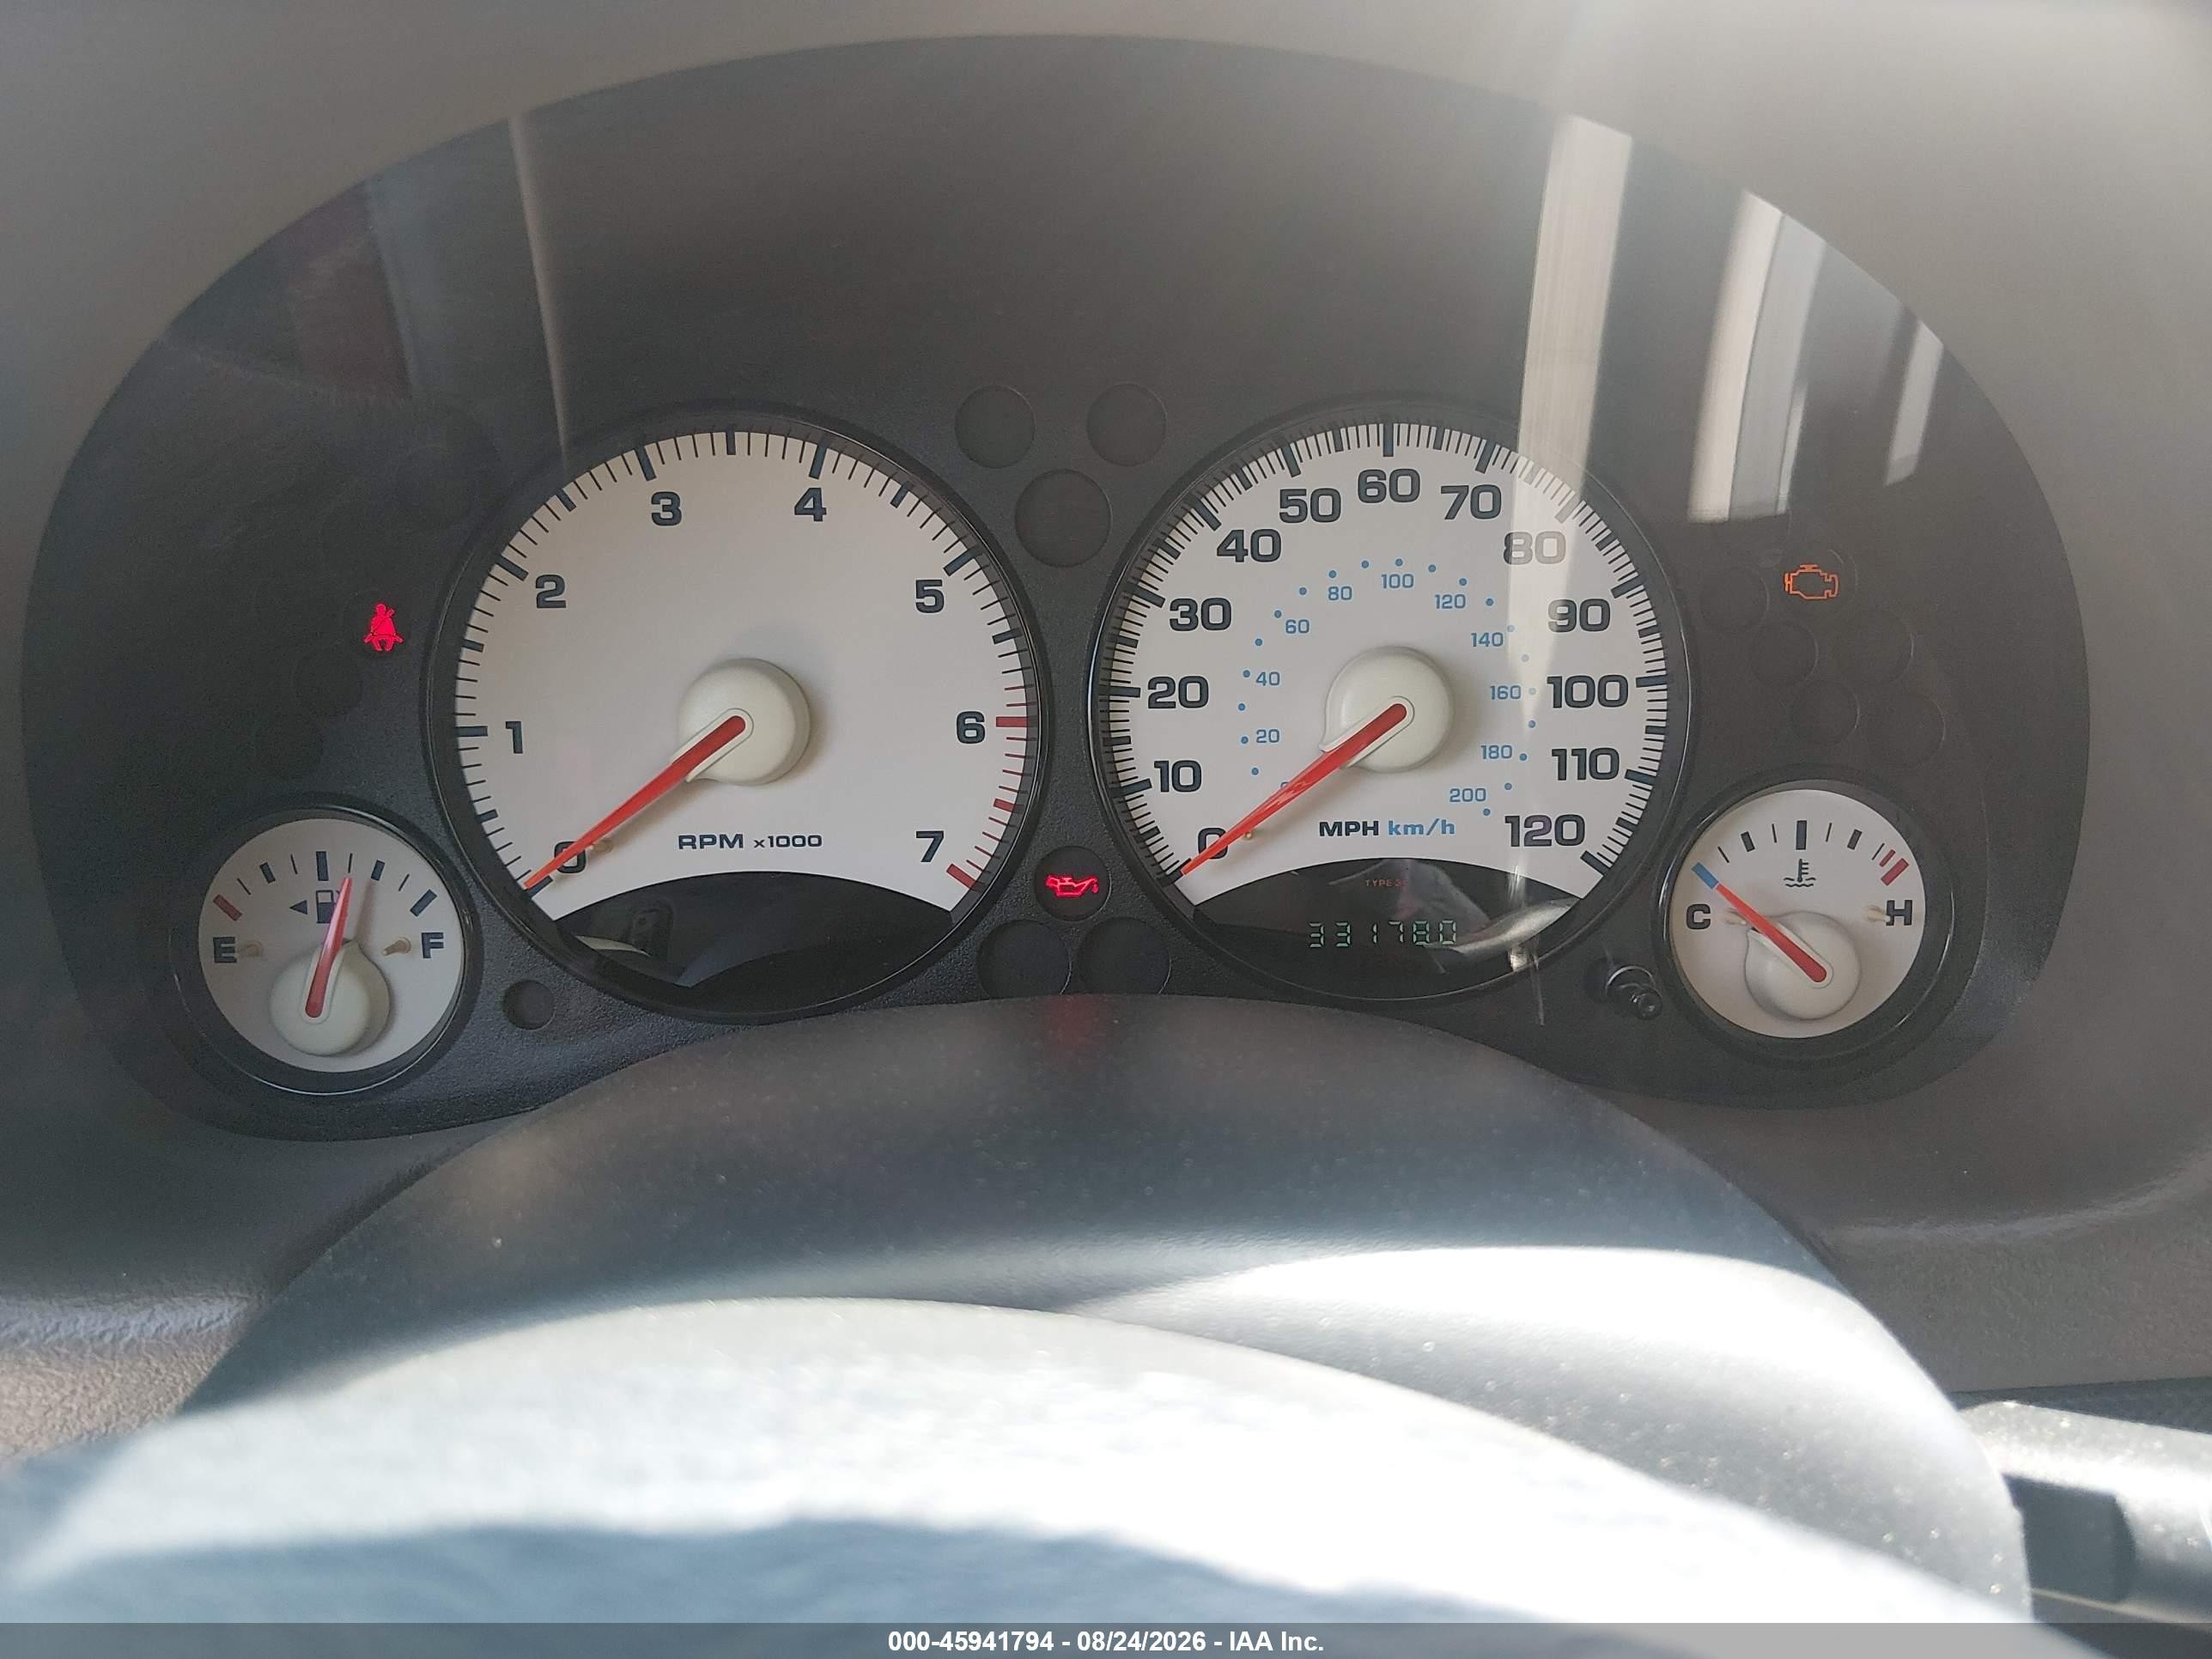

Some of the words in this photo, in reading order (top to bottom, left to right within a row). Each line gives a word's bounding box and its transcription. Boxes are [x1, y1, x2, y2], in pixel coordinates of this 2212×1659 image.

[1358, 469, 1420, 503] 60
[651, 492, 682, 526] 3
[794, 488, 826, 522] 4
[1279, 488, 1340, 523] 50
[1441, 484, 1501, 520] 70
[1217, 529, 1281, 562] 40
[1504, 532, 1566, 565] 80
[536, 574, 566, 608] 2
[916, 580, 945, 613] 5
[1328, 586, 1352, 600] 80
[1382, 574, 1413, 588] 100
[1170, 598, 1231, 631] 30
[1435, 594, 1466, 609] 120
[1548, 599, 1610, 632] 90
[1285, 619, 1310, 634] 60
[1471, 632, 1503, 647] 140
[1148, 676, 1208, 708] 20
[1256, 672, 1280, 686] 40
[1490, 685, 1521, 700] 160
[1547, 675, 1628, 708] 100
[506, 721, 523, 754] 1
[957, 712, 985, 744] 6
[1256, 729, 1280, 743] 20
[1481, 745, 1512, 759] 180
[1552, 747, 1620, 781] 110
[1154, 760, 1201, 792] 10
[1449, 788, 1486, 802] 200
[678, 834, 744, 849] RPM
[754, 836, 822, 848] x1000
[1320, 821, 1378, 836] MPH
[1389, 818, 1455, 836] km/h
[1505, 814, 1585, 847] 120
[555, 842, 586, 873] 0
[916, 831, 945, 862] 7
[1198, 828, 1228, 859] 0
[1686, 904, 1711, 929] C
[1886, 900, 1912, 926] H
[422, 933, 444, 958] F
[1310, 921, 1456, 947] 331780
[213, 937, 236, 963] E
